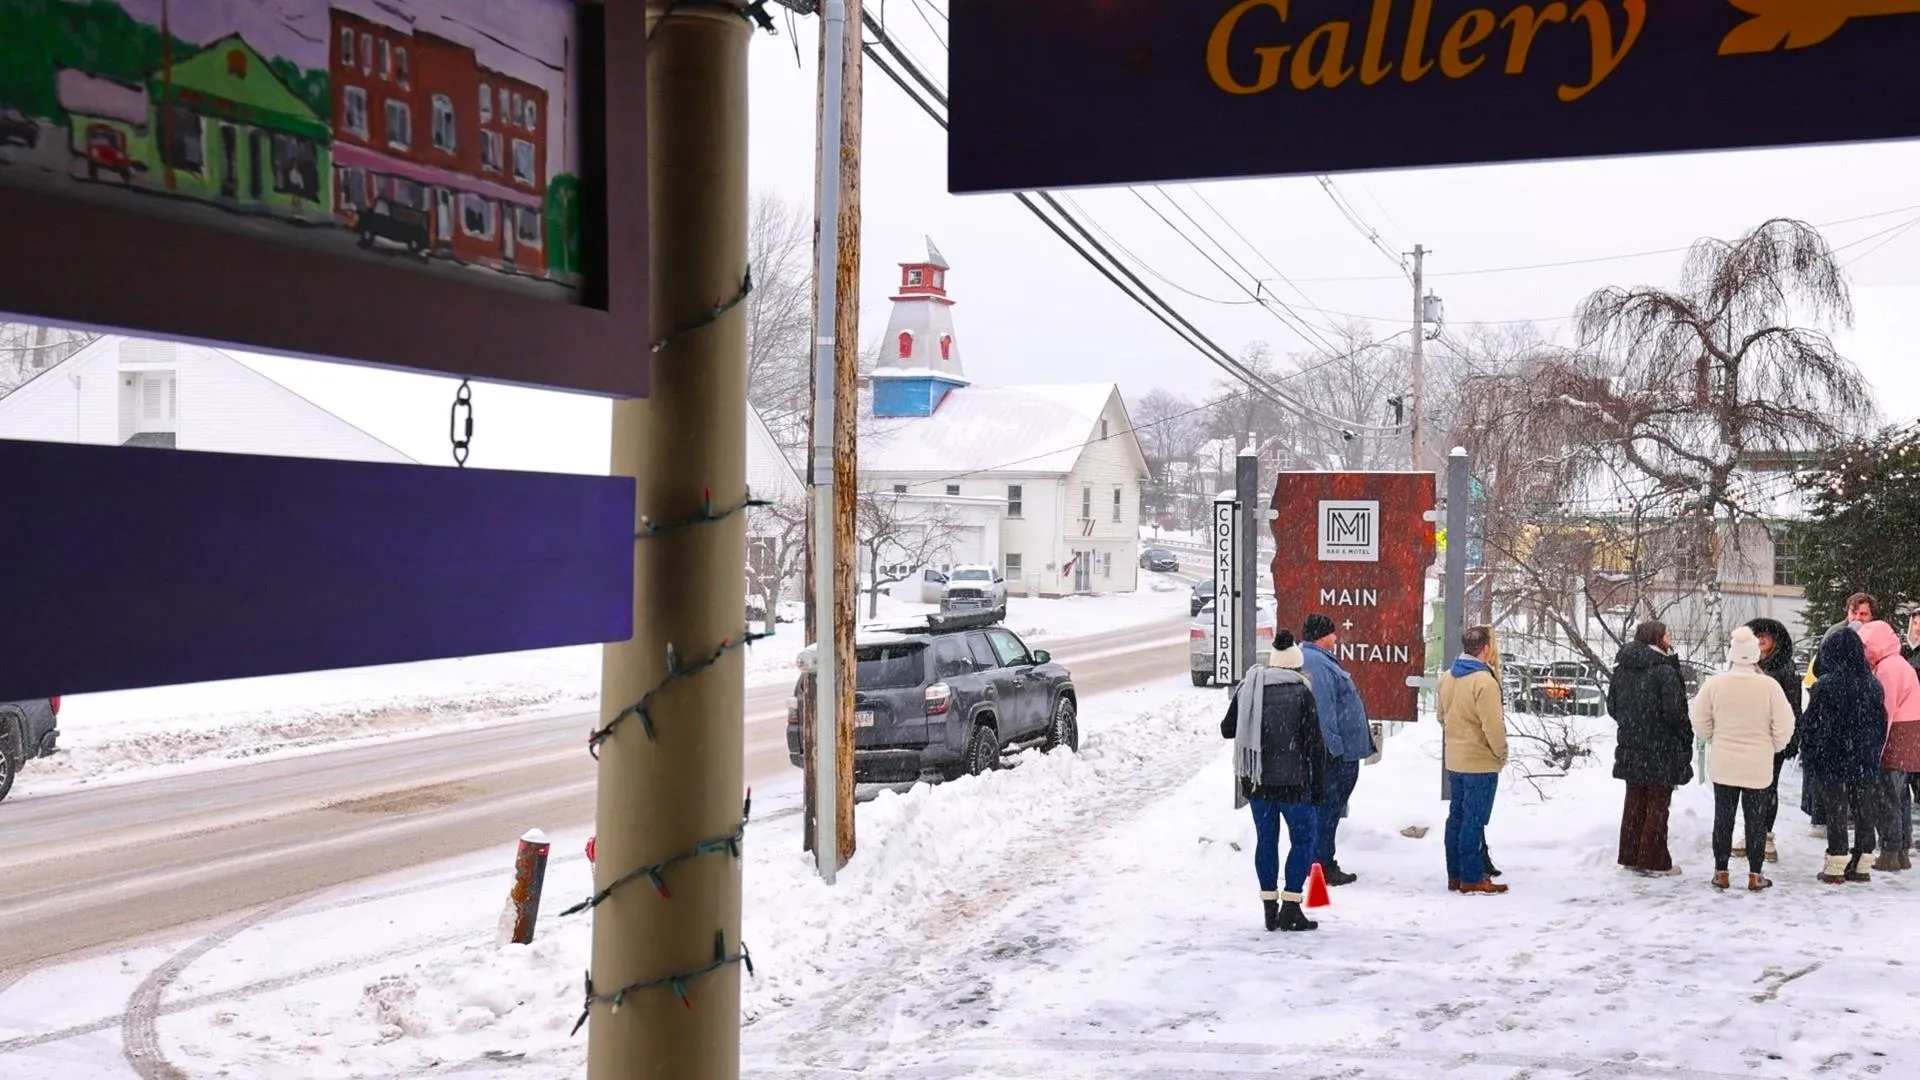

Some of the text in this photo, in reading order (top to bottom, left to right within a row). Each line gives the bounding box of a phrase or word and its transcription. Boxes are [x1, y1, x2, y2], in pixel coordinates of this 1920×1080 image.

[1206, 0, 1648, 102] Gallery
[1219, 507, 1230, 680] COCKTAIL BAR
[1320, 588, 1377, 606] MAIN
